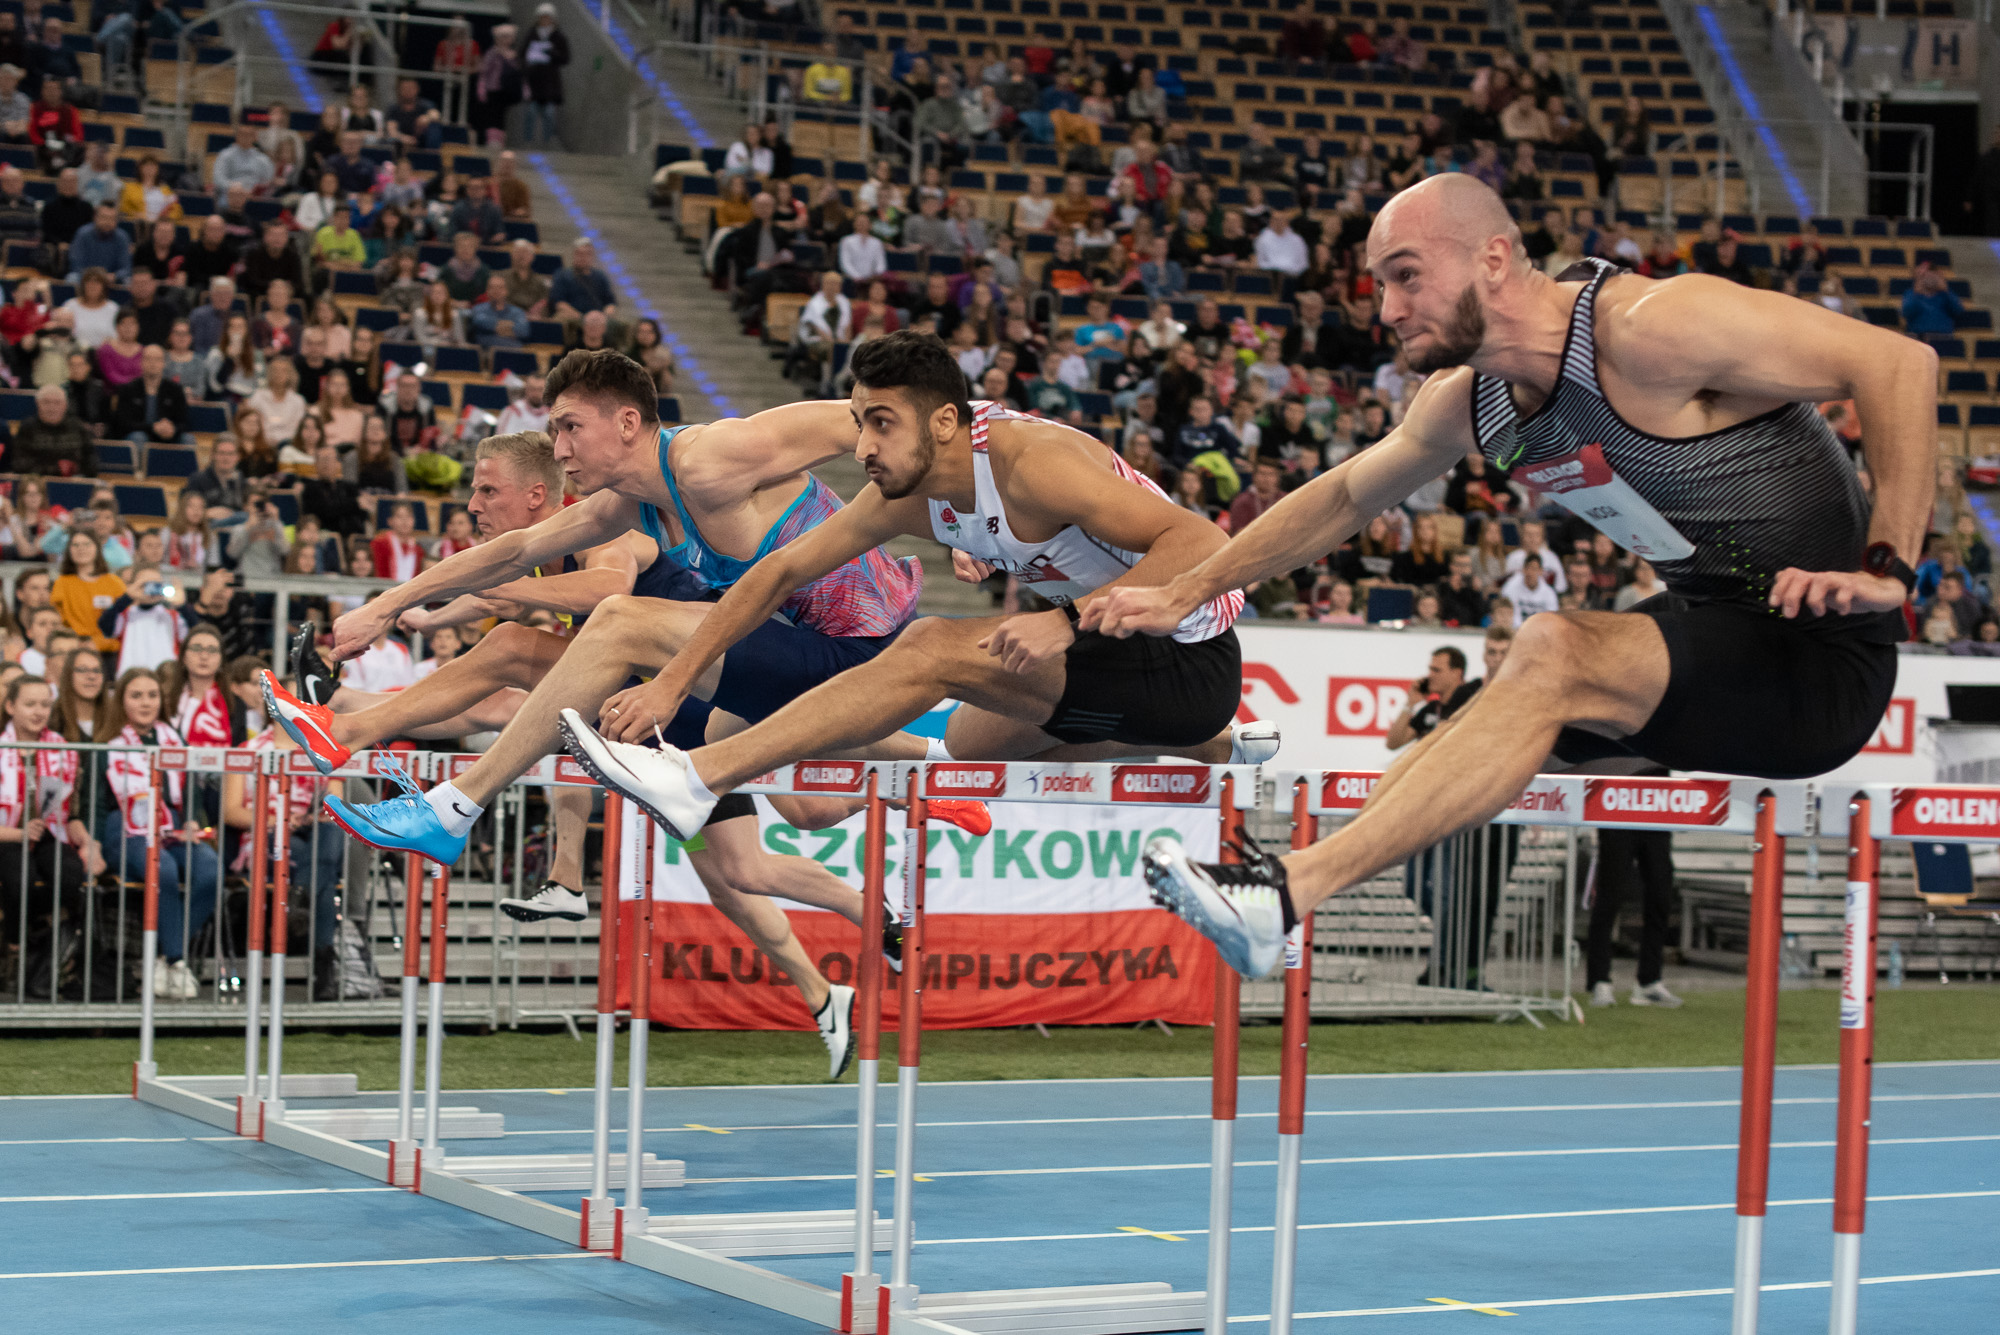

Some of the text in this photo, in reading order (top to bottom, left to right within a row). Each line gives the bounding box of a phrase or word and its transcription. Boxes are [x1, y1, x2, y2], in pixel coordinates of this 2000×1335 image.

[1042, 771, 1093, 796] polanik
[1507, 785, 1567, 811] lanik
[1914, 797, 1997, 825] ORLEN
[664, 823, 1184, 880] SZCZYKOW
